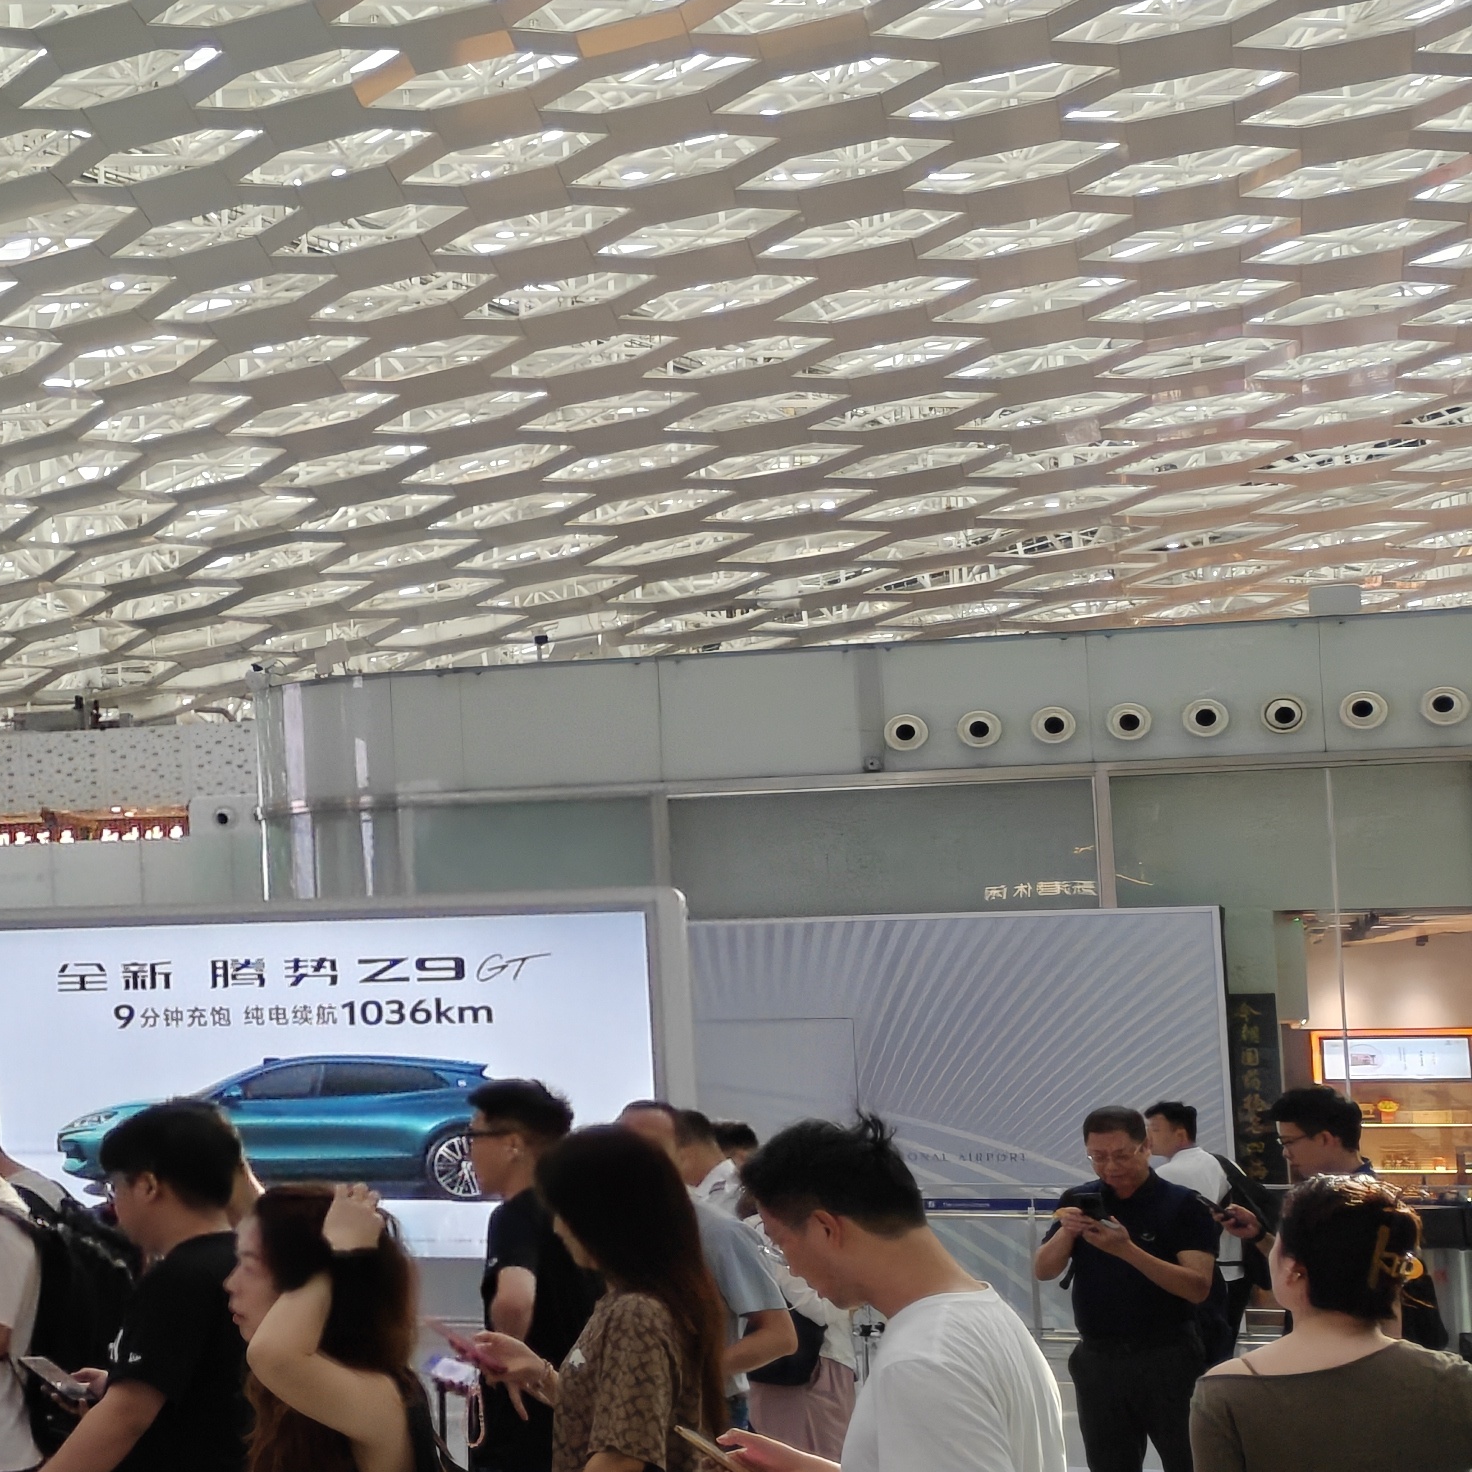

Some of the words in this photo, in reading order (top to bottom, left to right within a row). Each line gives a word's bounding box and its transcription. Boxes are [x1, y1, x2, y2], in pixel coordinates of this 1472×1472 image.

[57, 961, 173, 992] 全新
[113, 1004, 232, 1029] 9分钟充饱
[243, 998, 494, 1026] 纯电续航1036km
[907, 1152, 948, 1162] ONAL
[959, 1152, 1026, 1162] AIRPORT
